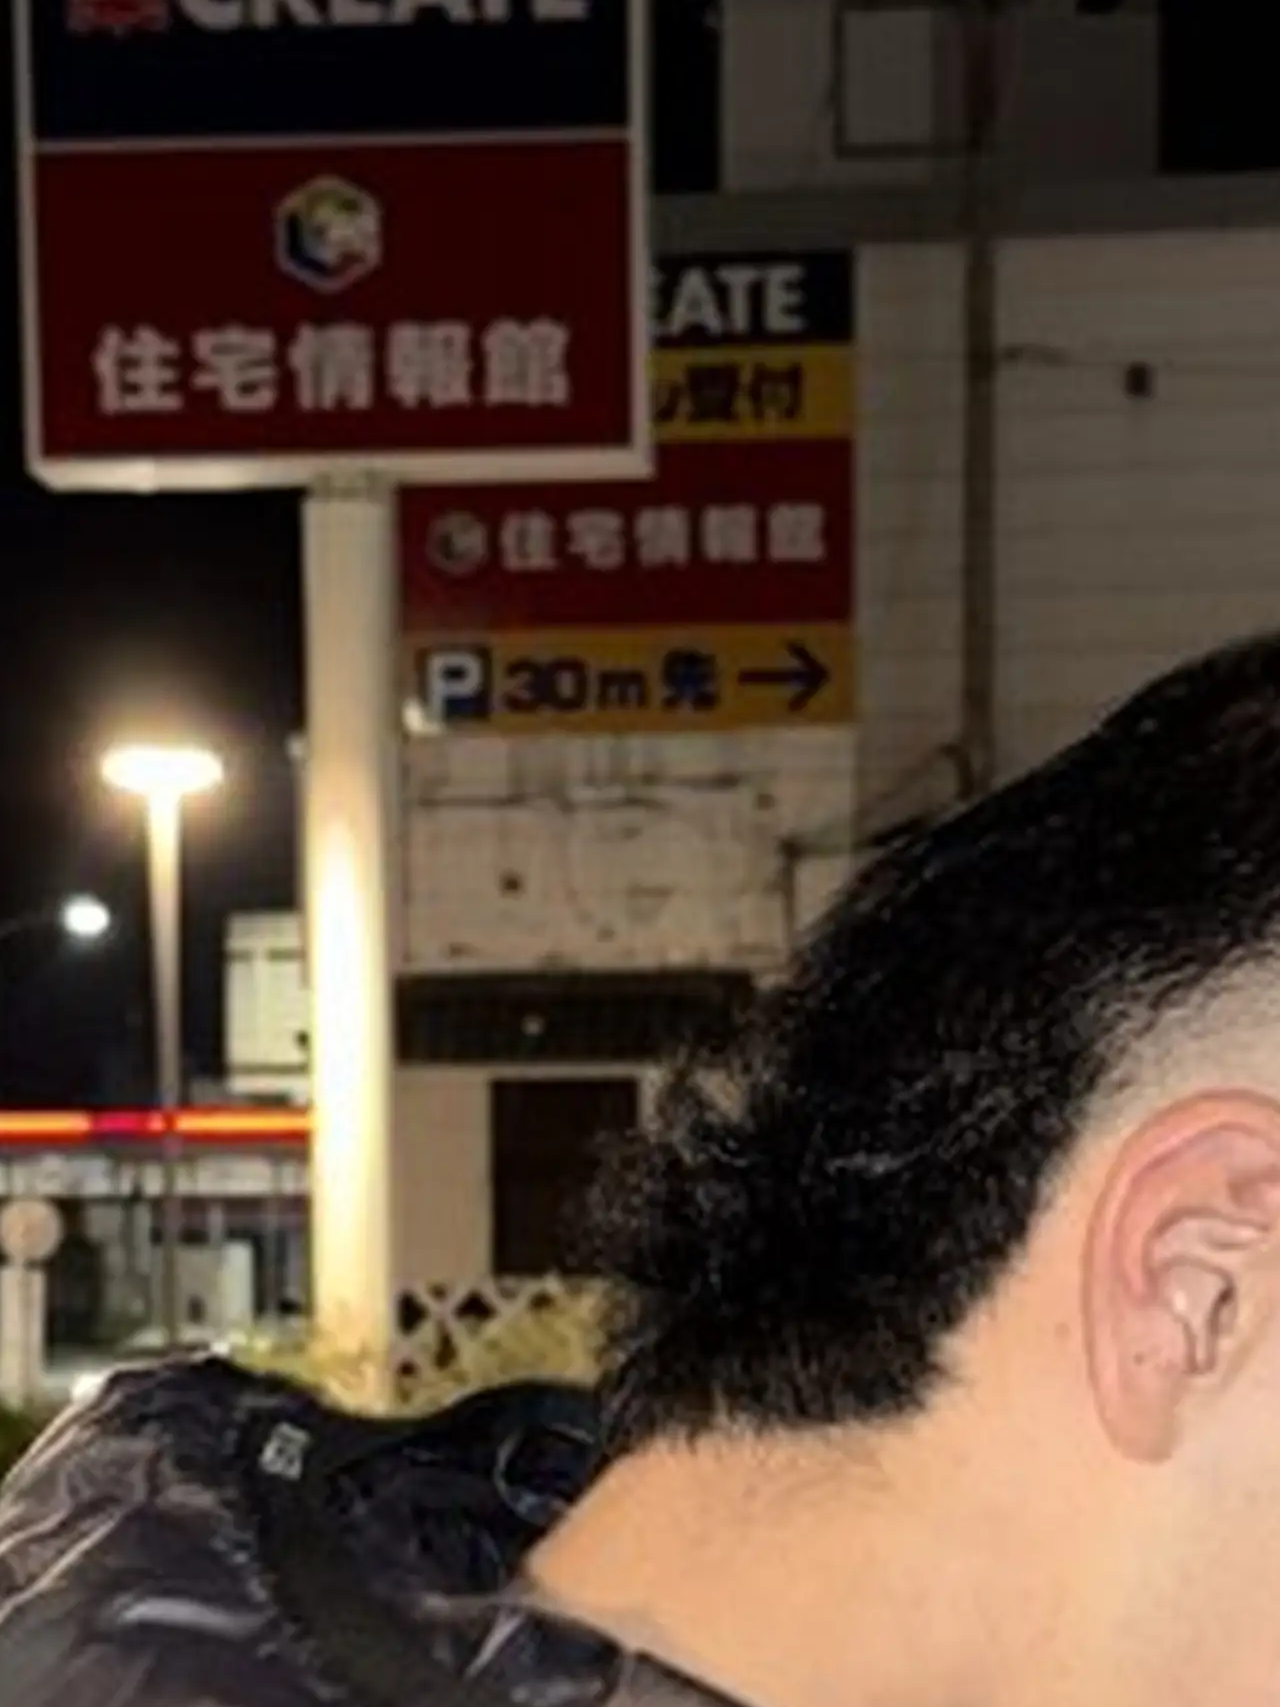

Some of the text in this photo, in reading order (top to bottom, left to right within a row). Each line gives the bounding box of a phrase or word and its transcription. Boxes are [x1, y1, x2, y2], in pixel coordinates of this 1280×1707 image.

[91, 316, 569, 415] 住宅情報館
